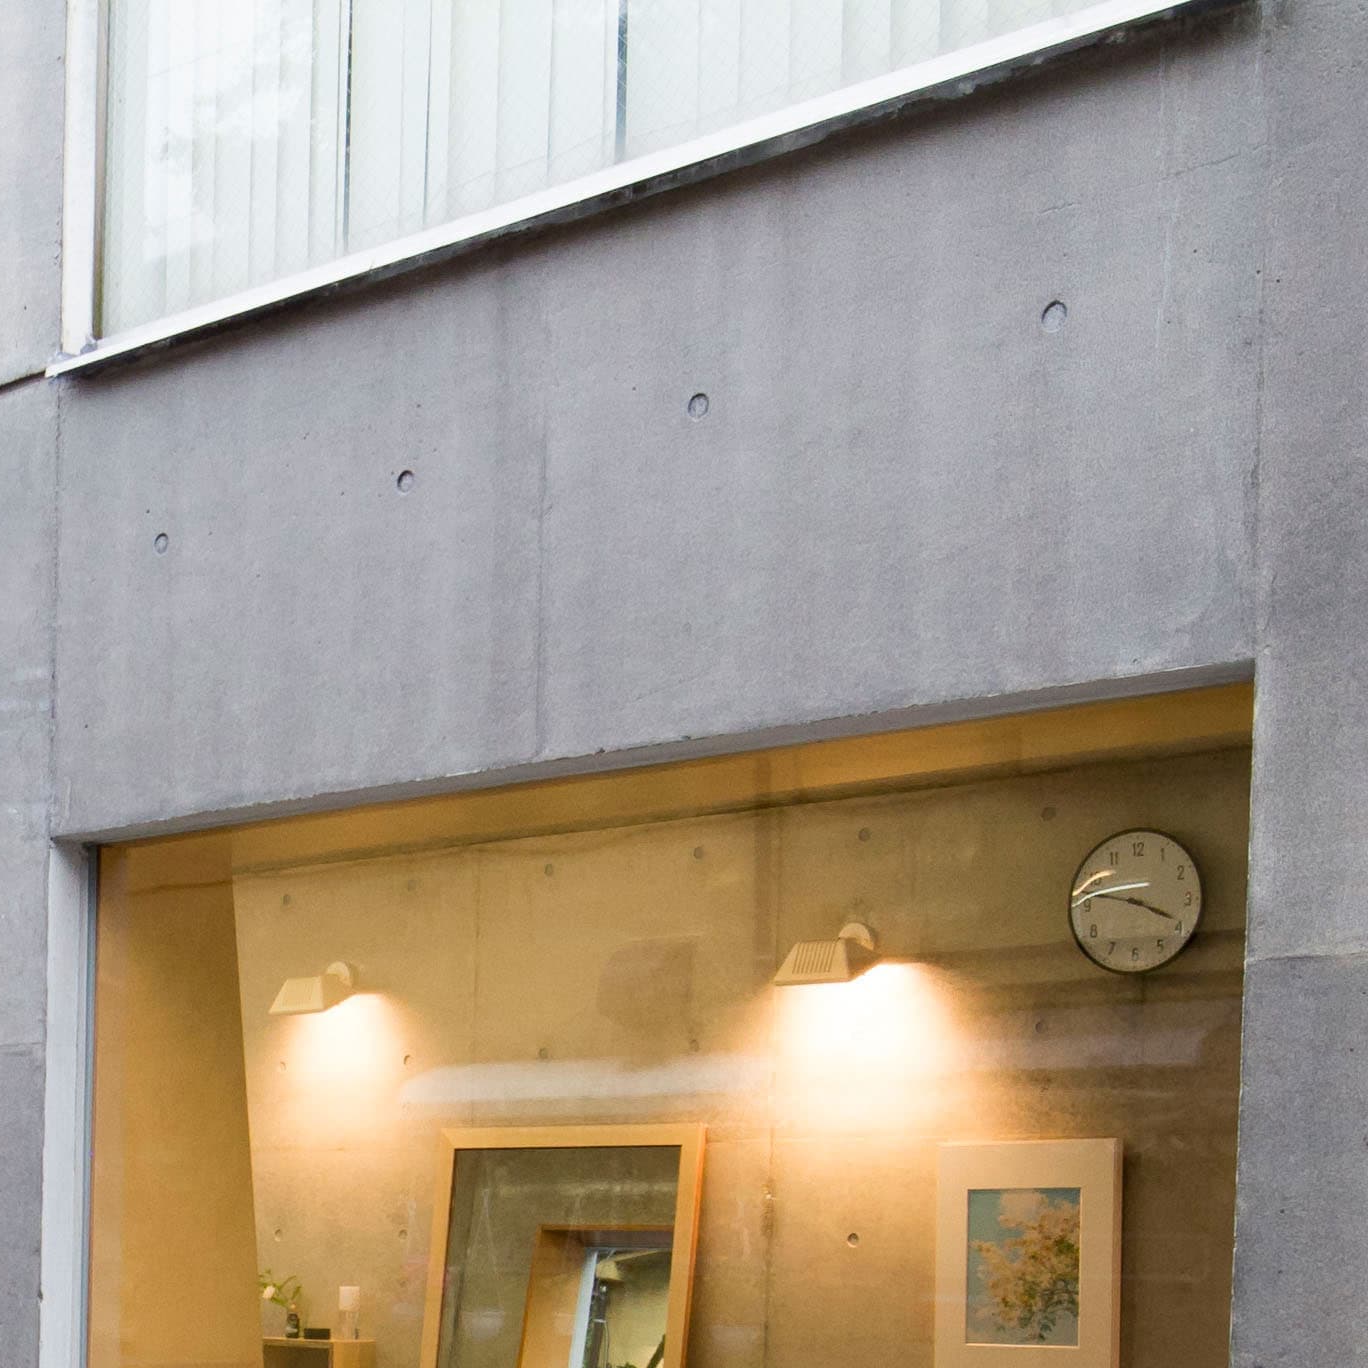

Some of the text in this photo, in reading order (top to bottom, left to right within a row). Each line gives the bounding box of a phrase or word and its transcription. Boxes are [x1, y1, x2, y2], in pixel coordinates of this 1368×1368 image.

[1132, 842, 1145, 857] 12
[1160, 847, 1166, 861] 1
[1109, 851, 1119, 866] 11
[1177, 865, 1185, 880] 2
[1083, 898, 1092, 912] 9
[1184, 891, 1192, 906] 3
[1090, 924, 1098, 938] 8
[1175, 921, 1184, 936] 4
[1108, 941, 1116, 955] 7
[1132, 947, 1140, 961] 6
[1157, 939, 1164, 954] 5
